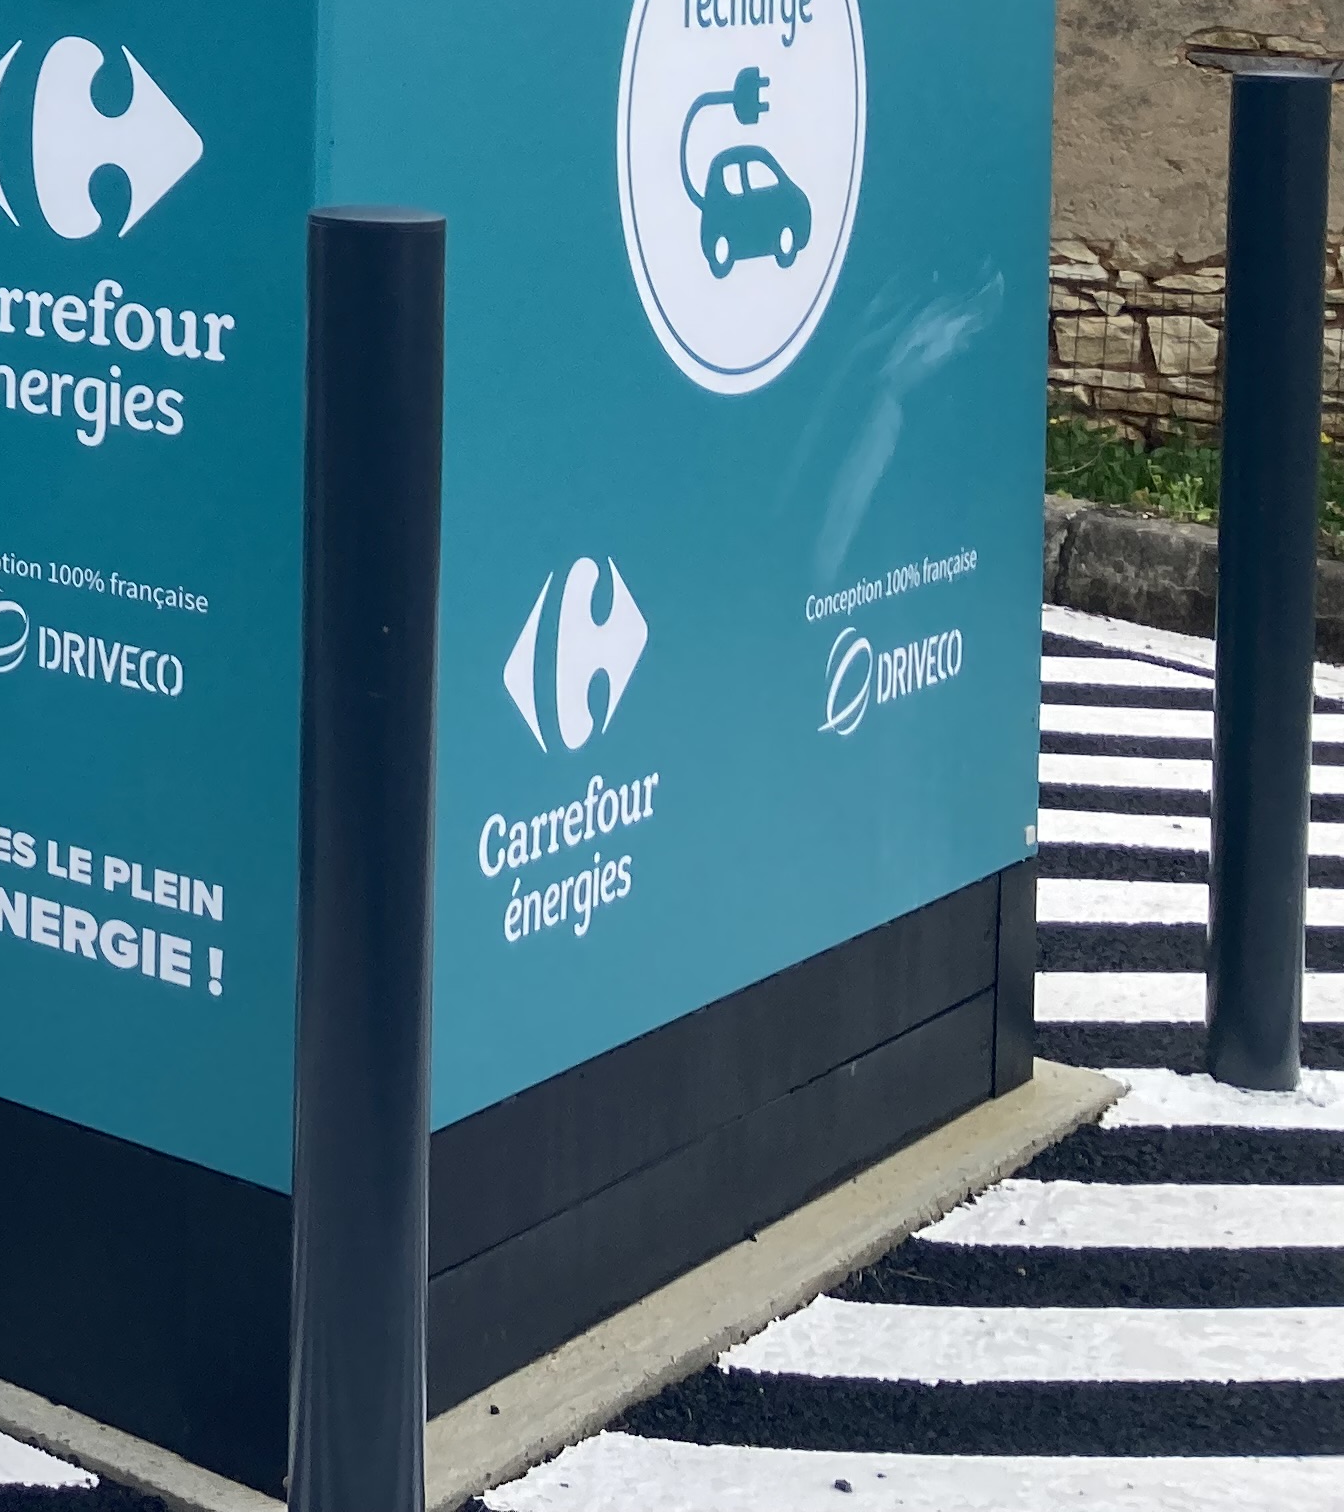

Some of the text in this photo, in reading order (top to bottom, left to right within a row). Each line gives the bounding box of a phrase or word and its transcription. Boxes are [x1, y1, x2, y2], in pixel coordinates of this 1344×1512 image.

[48, 562, 105, 594] 100%
[109, 571, 210, 614] française
[805, 546, 978, 622] Conception 100% française
[38, 625, 185, 697] DRIVECO
[876, 628, 964, 705] DRIVECO
[477, 772, 660, 879] Carrefour
[47, 839, 93, 886] LE
[103, 854, 225, 922] PLEIN
[503, 851, 633, 943] énergies
